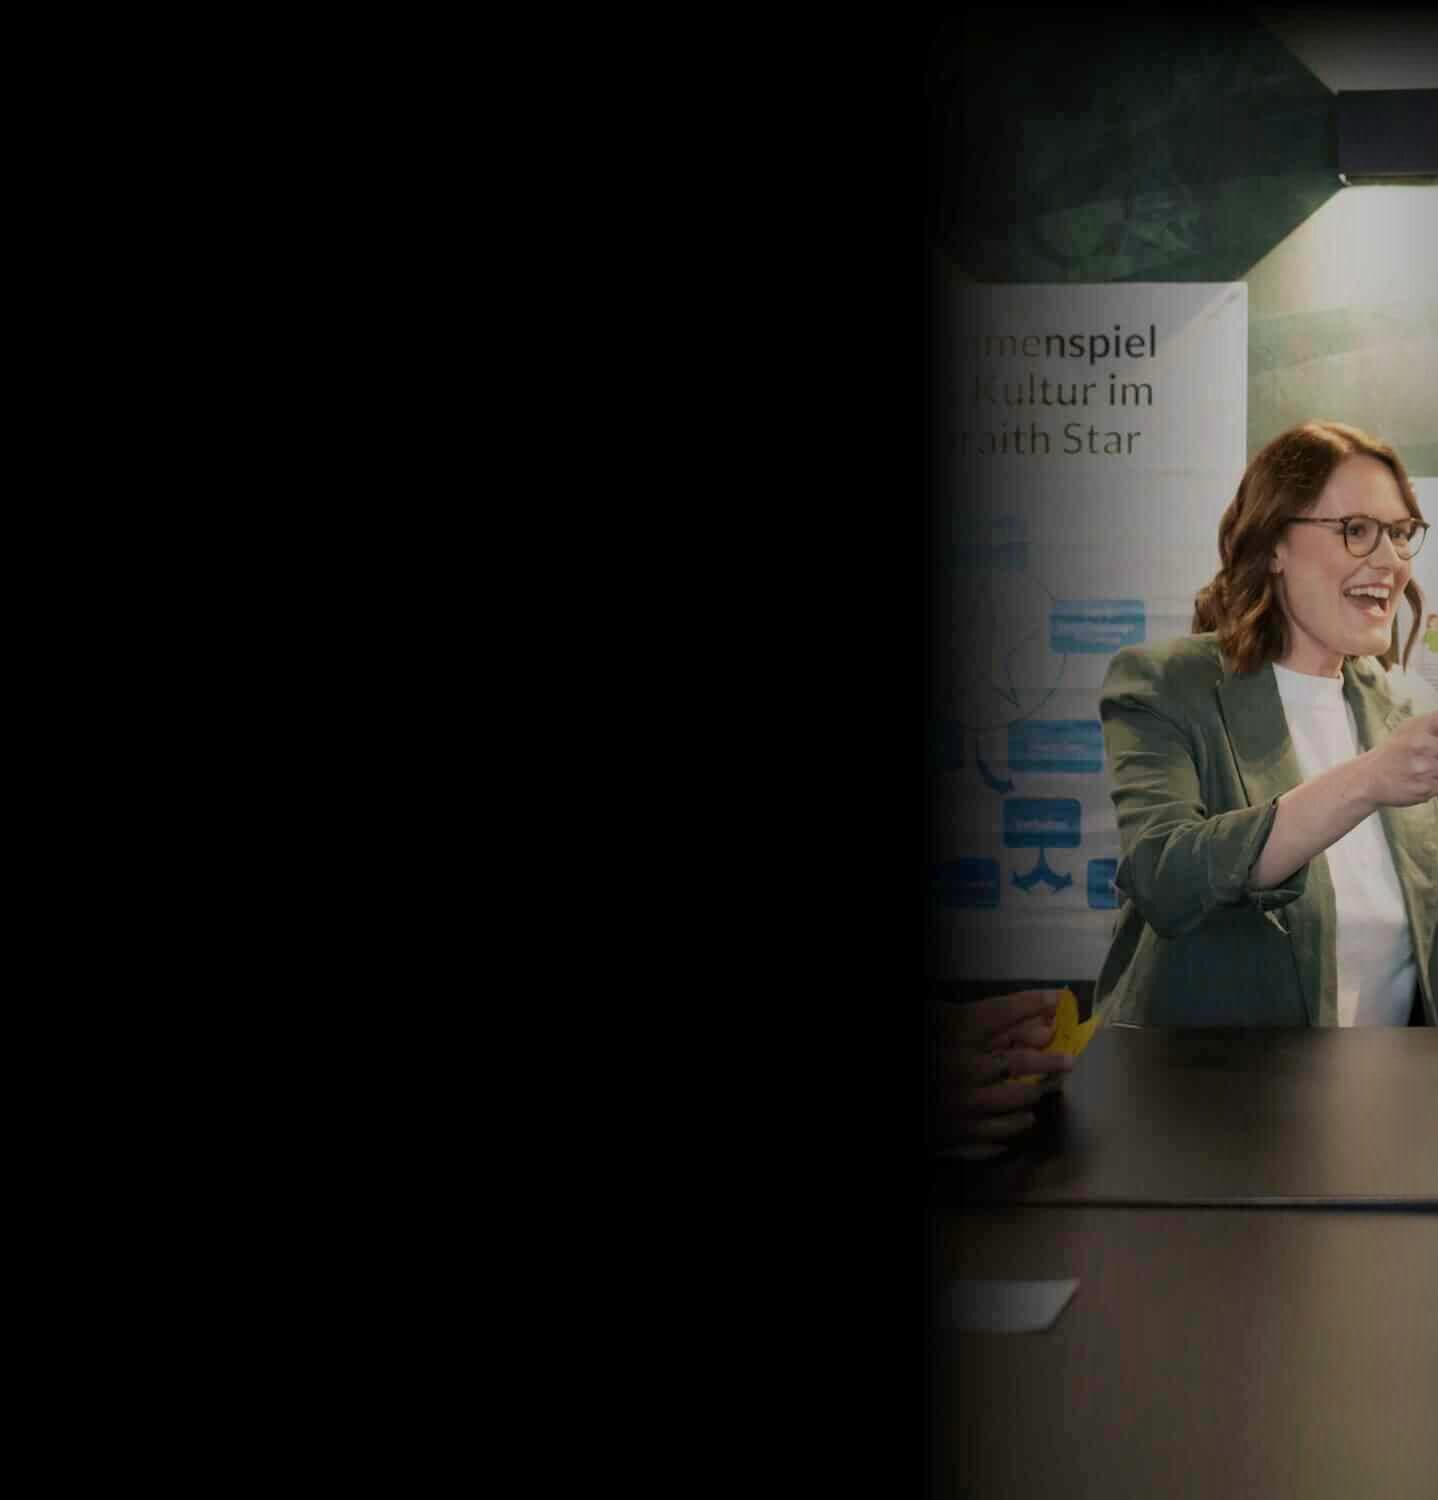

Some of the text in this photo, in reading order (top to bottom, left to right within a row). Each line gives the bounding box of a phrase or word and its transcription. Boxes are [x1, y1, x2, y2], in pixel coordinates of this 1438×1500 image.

[982, 324, 1156, 365] menspiel
[1108, 373, 1153, 406] im
[1062, 421, 1142, 456] Star
